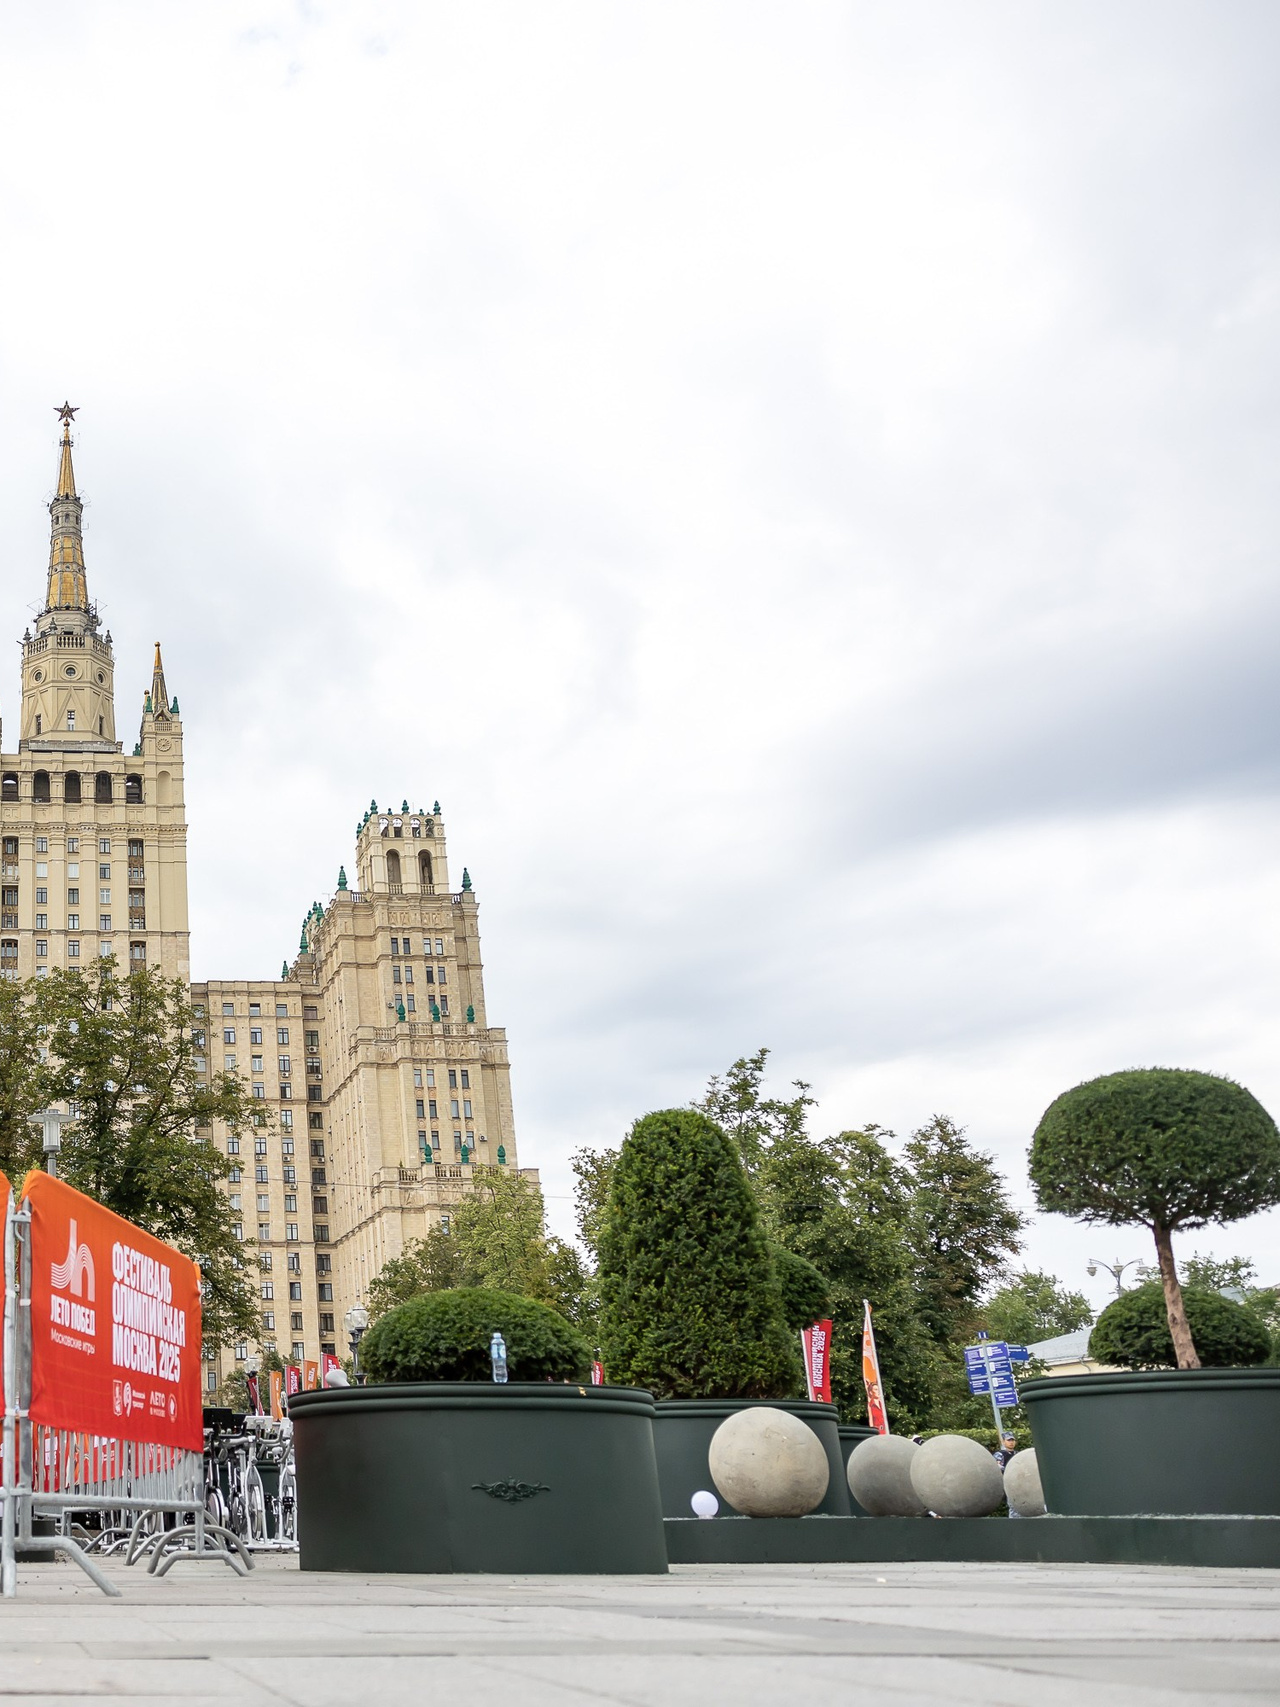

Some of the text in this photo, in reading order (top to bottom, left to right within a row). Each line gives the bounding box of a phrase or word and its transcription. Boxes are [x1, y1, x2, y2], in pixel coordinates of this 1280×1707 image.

[112, 1241, 173, 1305] ФЕСТИВАЛЬ
[50, 1293, 96, 1337] ЛЕТО ПОБЕД
[112, 1281, 186, 1348] ОЛИМПИЙСКАЯ
[112, 1322, 180, 1383] МОСКВА 2025
